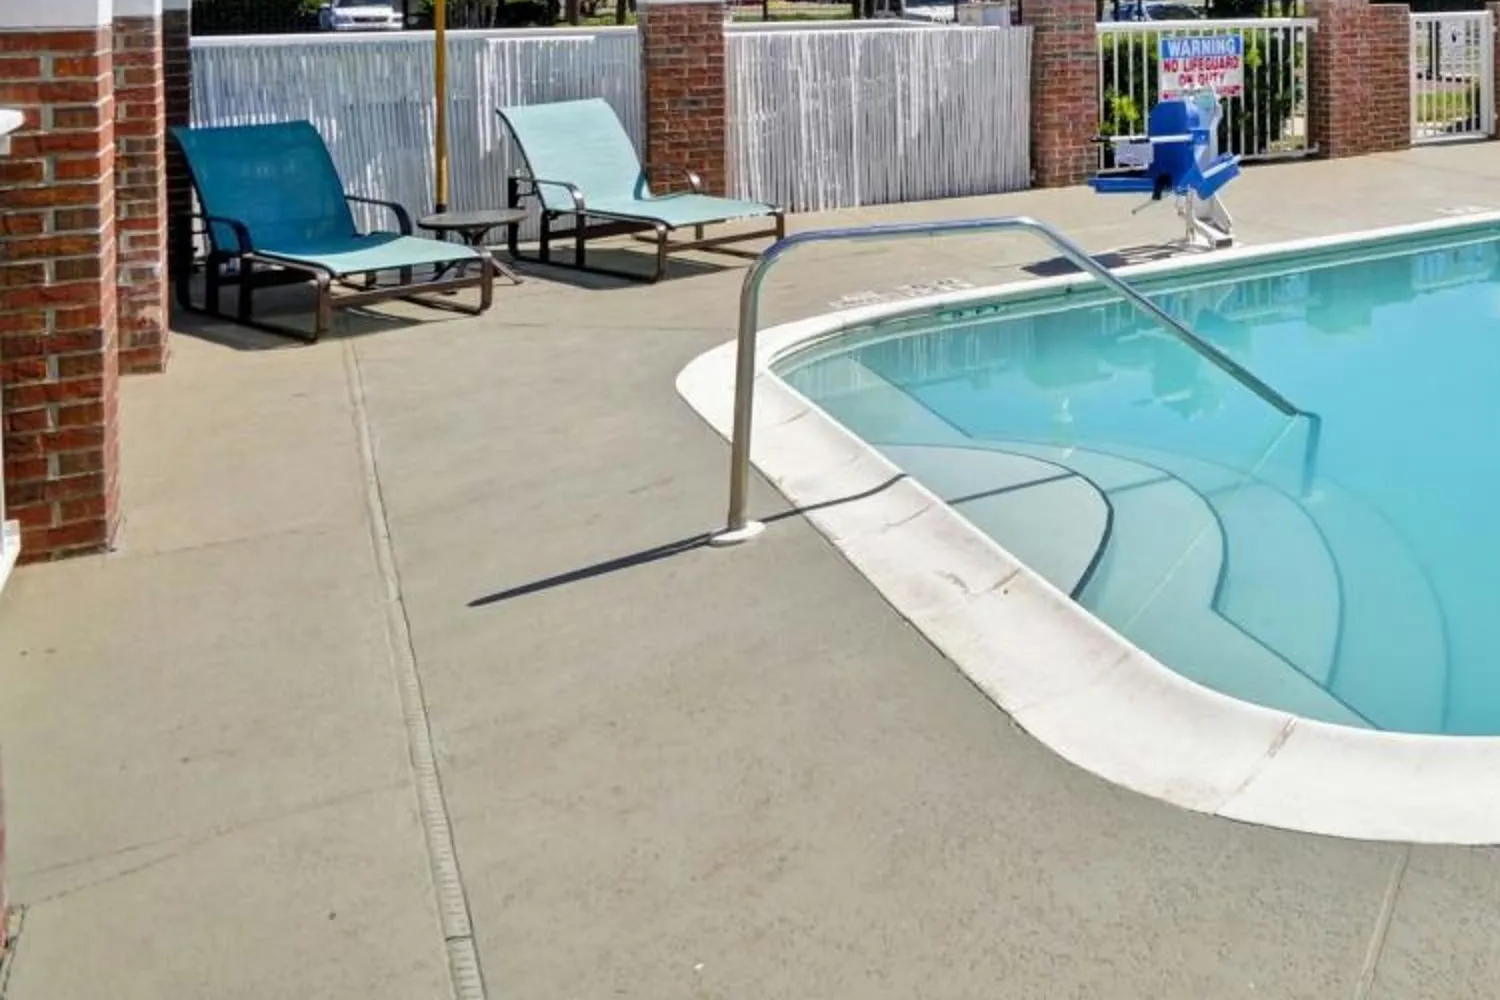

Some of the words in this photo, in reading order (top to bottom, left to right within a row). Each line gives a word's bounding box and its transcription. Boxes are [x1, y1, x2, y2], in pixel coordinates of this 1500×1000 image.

[1167, 38, 1235, 56] WARNING
[1163, 59, 1178, 72] NO
[1183, 55, 1239, 71] LIFEGUARD
[1198, 72, 1224, 86] DUTY
